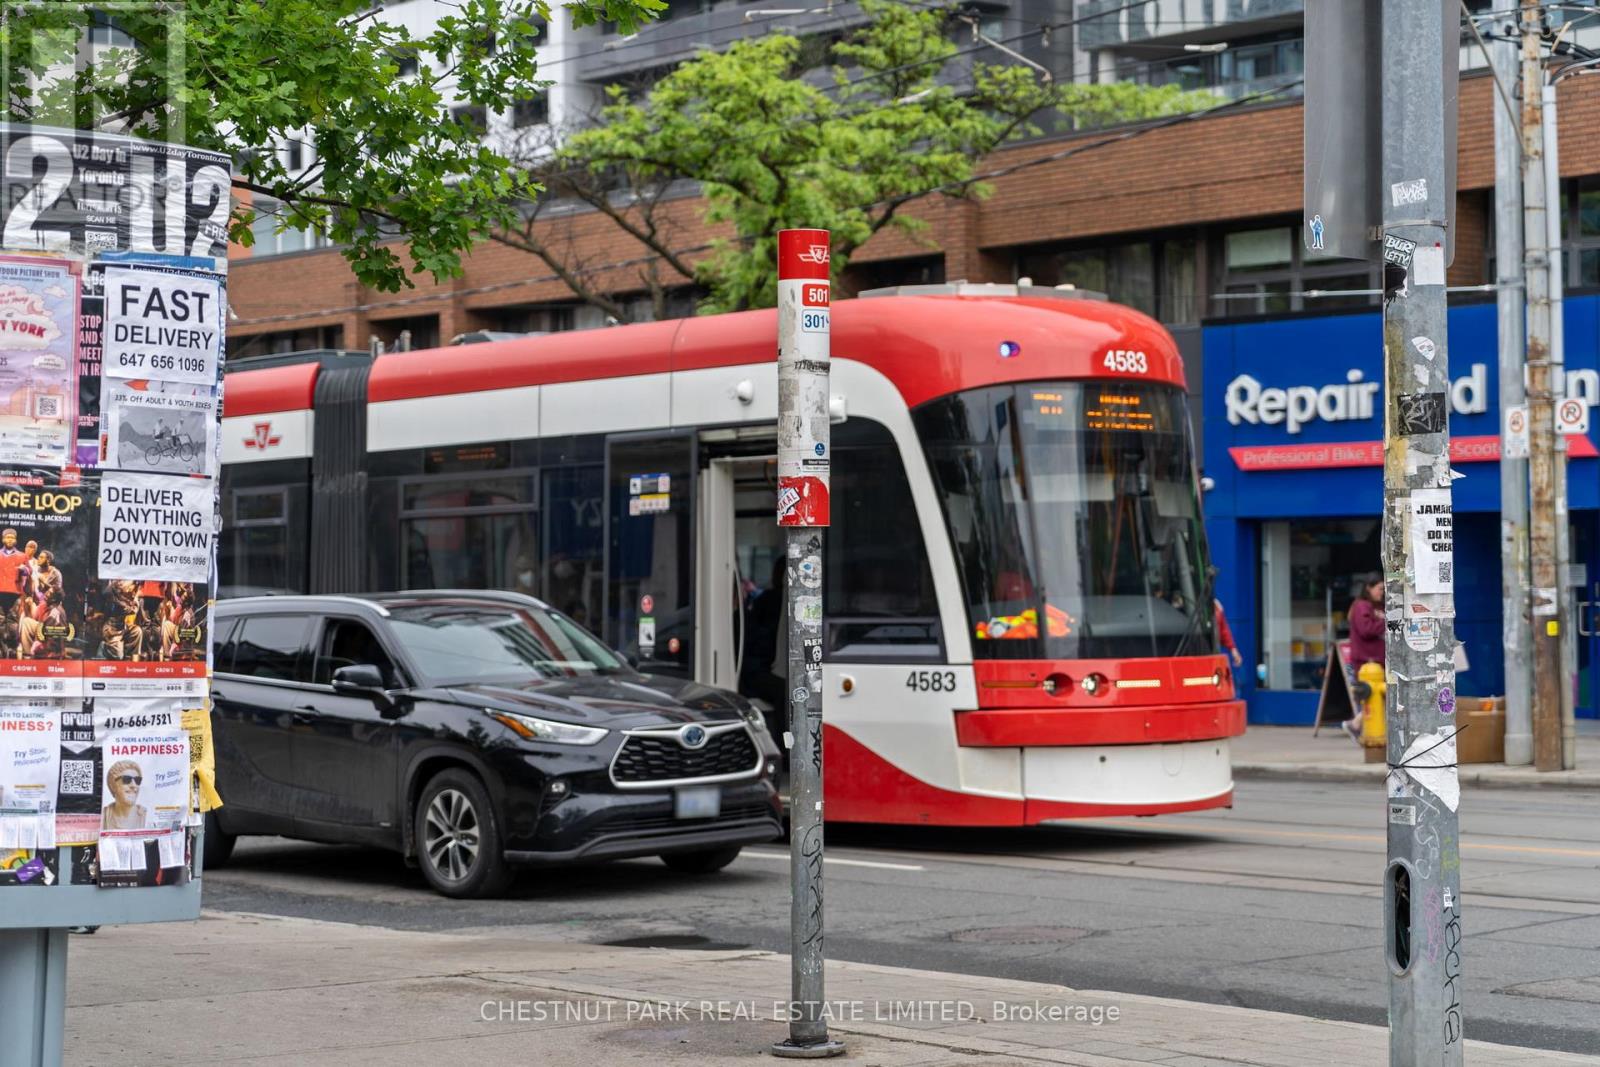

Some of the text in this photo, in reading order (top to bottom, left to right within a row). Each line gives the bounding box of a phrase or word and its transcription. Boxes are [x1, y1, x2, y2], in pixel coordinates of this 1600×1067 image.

[91, 146, 114, 164] Day
[121, 284, 210, 324] FAST
[809, 288, 829, 303] 501
[11, 320, 46, 338] YORK
[80, 314, 102, 329] STOP
[804, 314, 825, 329] 301
[80, 330, 98, 345] AND
[114, 324, 213, 350] DELIVERY
[119, 353, 205, 373] 647 656 1096
[1103, 349, 1149, 374] 4583
[174, 400, 194, 408] YOUTH
[1225, 368, 1380, 434] Repair
[1243, 448, 1330, 466] Professional
[34, 492, 82, 515] LOOP
[107, 486, 184, 507] DELIVER
[8, 513, 36, 521] MICHAEL
[44, 515, 72, 523] JACKSON
[113, 507, 202, 527] ANYTHING
[103, 527, 208, 549] DOWNTOWN
[1427, 530, 1442, 539] DO
[101, 548, 123, 565] 20
[128, 549, 161, 567] MIN
[164, 555, 178, 564] 647
[906, 671, 956, 692] 4583
[0, 720, 53, 731] INESS?
[104, 713, 173, 729] 416-666-7521
[111, 744, 184, 756] HAPPINESS?
